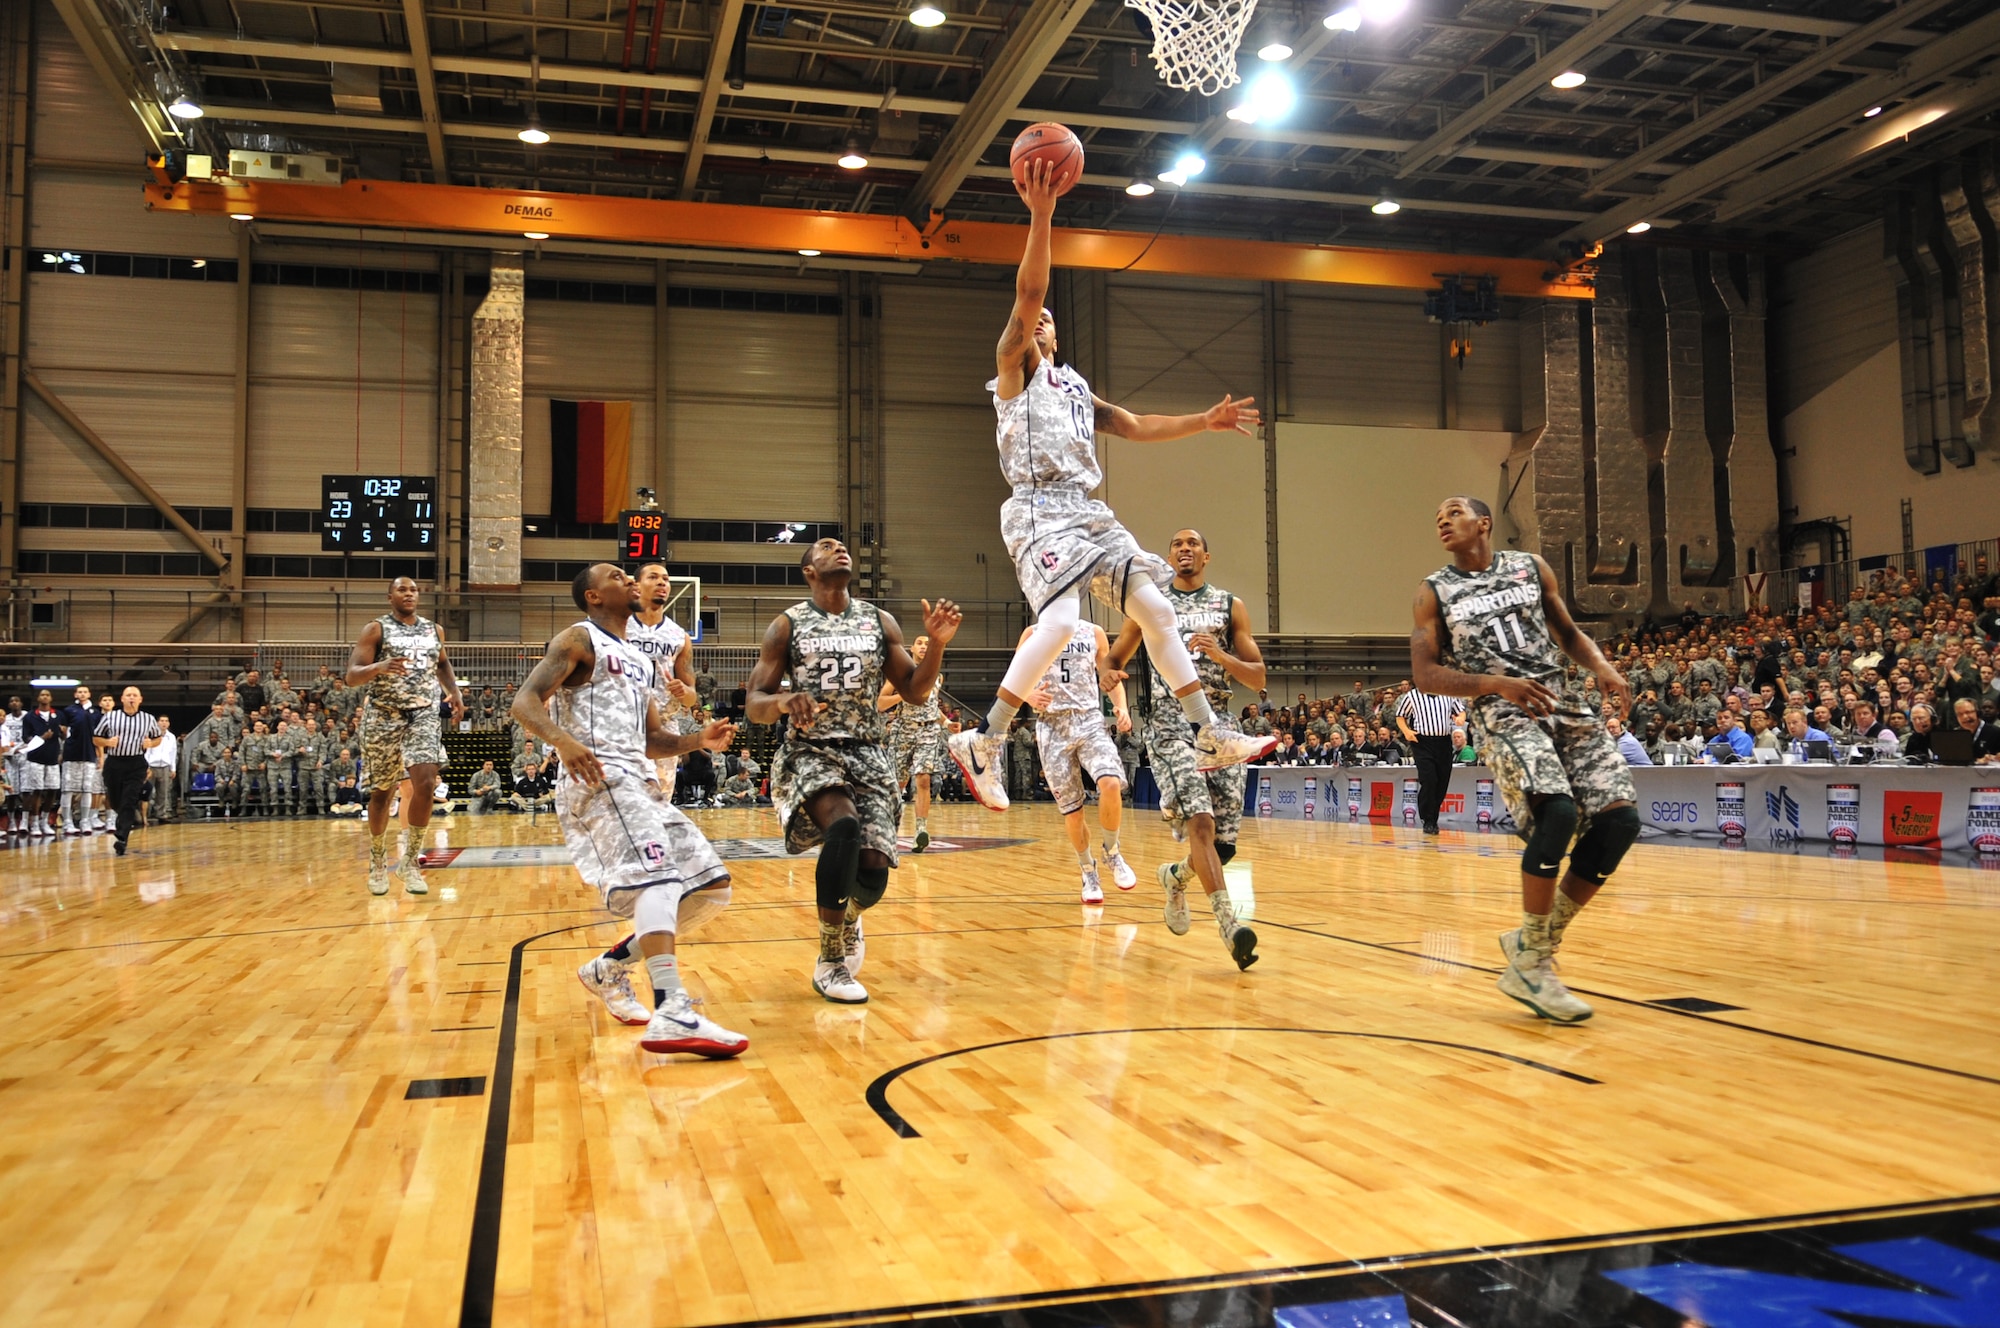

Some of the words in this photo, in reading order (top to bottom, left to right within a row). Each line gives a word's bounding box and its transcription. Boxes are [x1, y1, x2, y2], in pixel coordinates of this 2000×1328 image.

[504, 204, 553, 217] DEMAG
[945, 233, 961, 243] 15t
[364, 479, 401, 496] 10:32
[330, 501, 352, 518] 23
[379, 506, 384, 517] 1
[416, 503, 431, 518] 11
[629, 515, 662, 529] 10:32
[331, 530, 340, 541] 4
[387, 531, 395, 542] 4
[421, 530, 429, 543] 3
[629, 533, 659, 557] 31
[1450, 584, 1538, 620] SPARTANS
[1487, 613, 1527, 653] 11
[799, 635, 877, 654] SPARTANS
[820, 656, 861, 690] 22
[1061, 659, 1070, 683] 5
[1651, 801, 1698, 823] sears
[1828, 806, 1858, 814] ARMED
[1895, 824, 1931, 836] ENERGY
